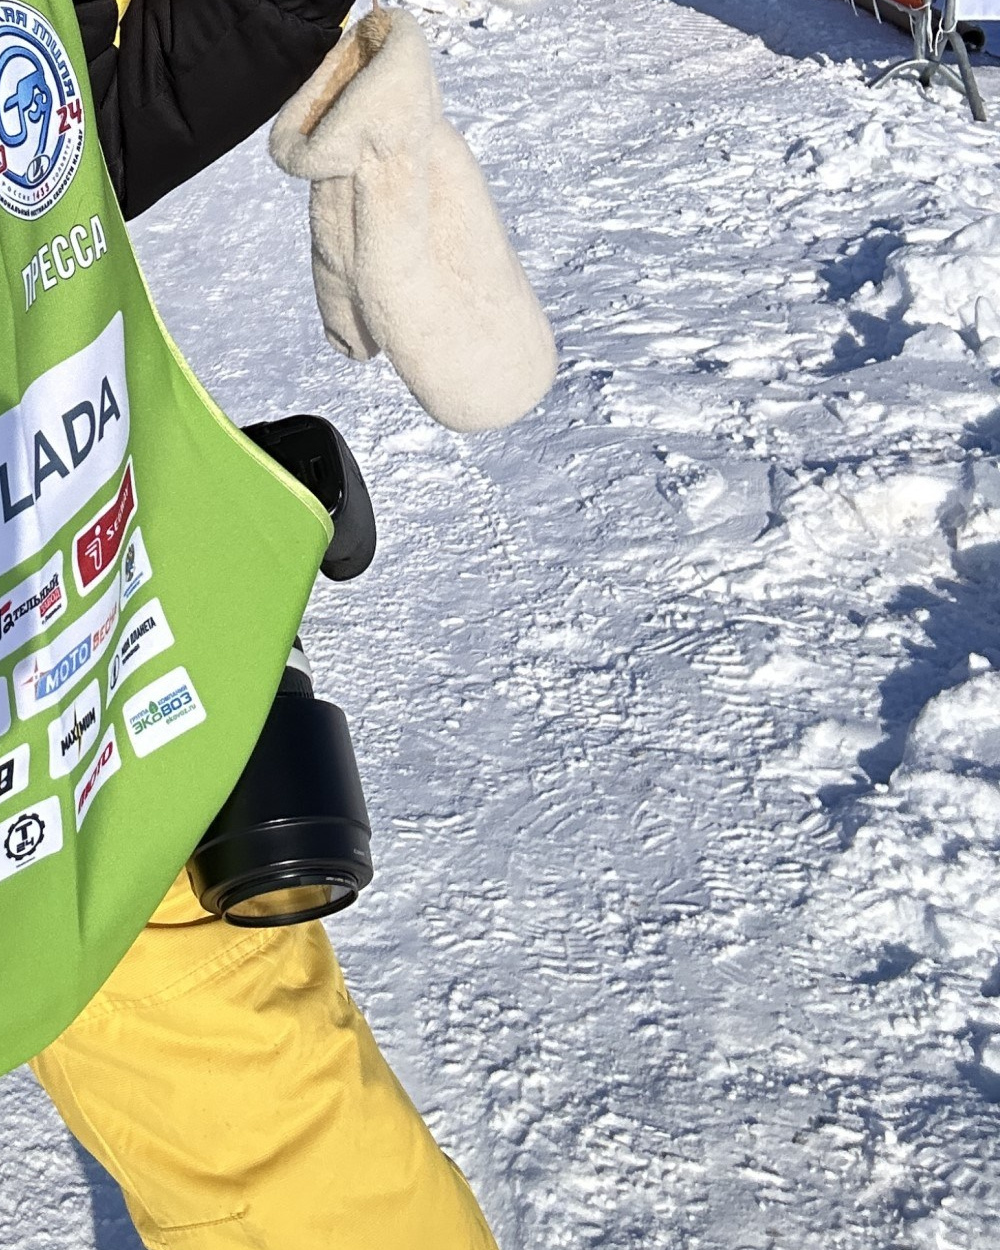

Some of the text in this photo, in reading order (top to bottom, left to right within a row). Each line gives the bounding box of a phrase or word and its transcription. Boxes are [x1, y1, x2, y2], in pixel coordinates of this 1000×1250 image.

[32, 18, 76, 97] МИЛЯ
[56, 98, 82, 134] 24
[21, 213, 108, 315] ПРЕССА
[132, 691, 193, 735] ЭКОВОЗ
[165, 703, 197, 725] ekovoz.ru
